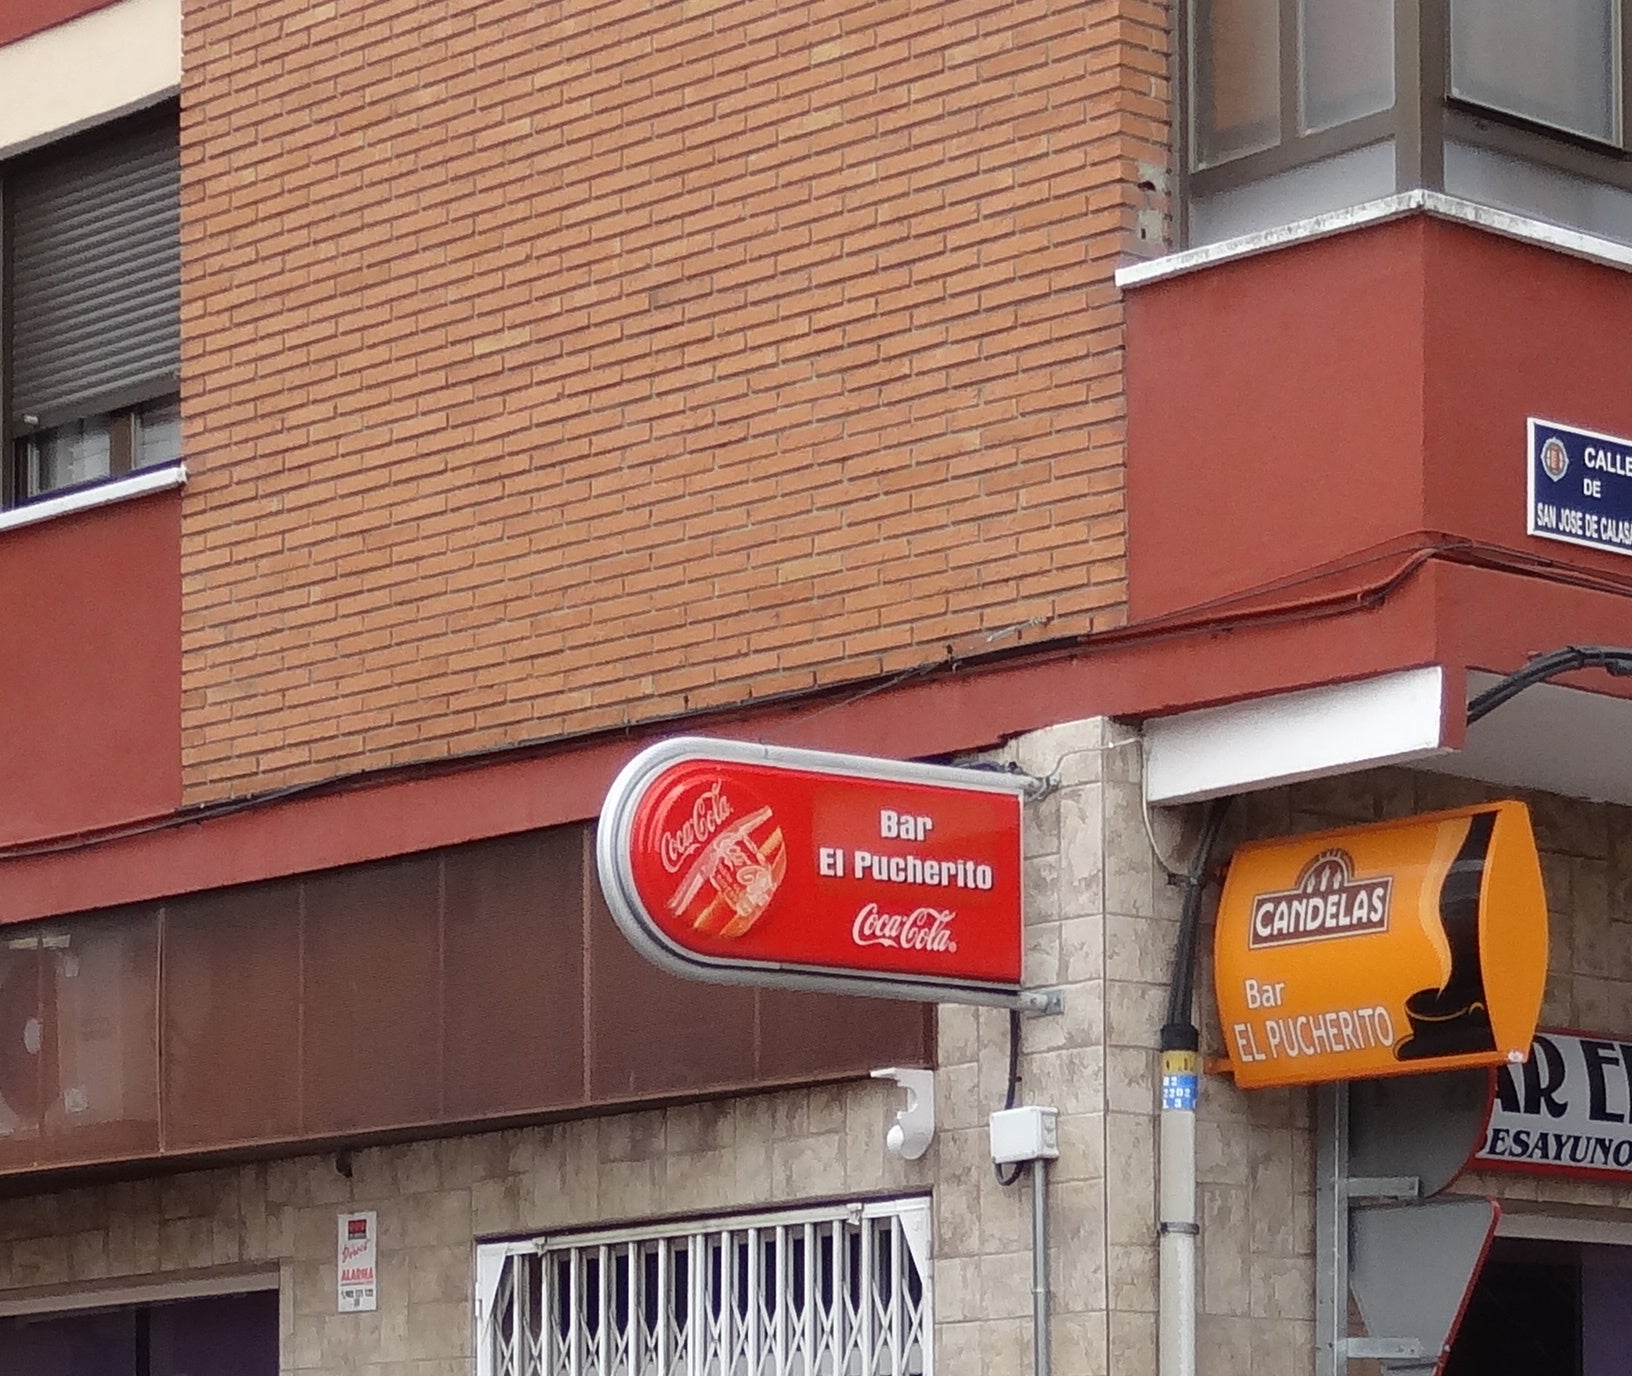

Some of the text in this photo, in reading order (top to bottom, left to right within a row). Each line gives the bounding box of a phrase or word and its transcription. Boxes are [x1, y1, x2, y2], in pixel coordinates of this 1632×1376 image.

[1583, 478, 1601, 498] DE
[1537, 502, 1556, 529] SAN
[1558, 508, 1583, 535] JOSE
[1585, 513, 1598, 539] DE
[880, 809, 933, 842] Bar
[819, 847, 994, 891] El Pucherito
[852, 901, 956, 953] Coca-Cola
[1254, 886, 1384, 938] CANDELAS
[1244, 978, 1285, 1009] Bar
[1233, 1005, 1395, 1063] EL PUCHERITO
